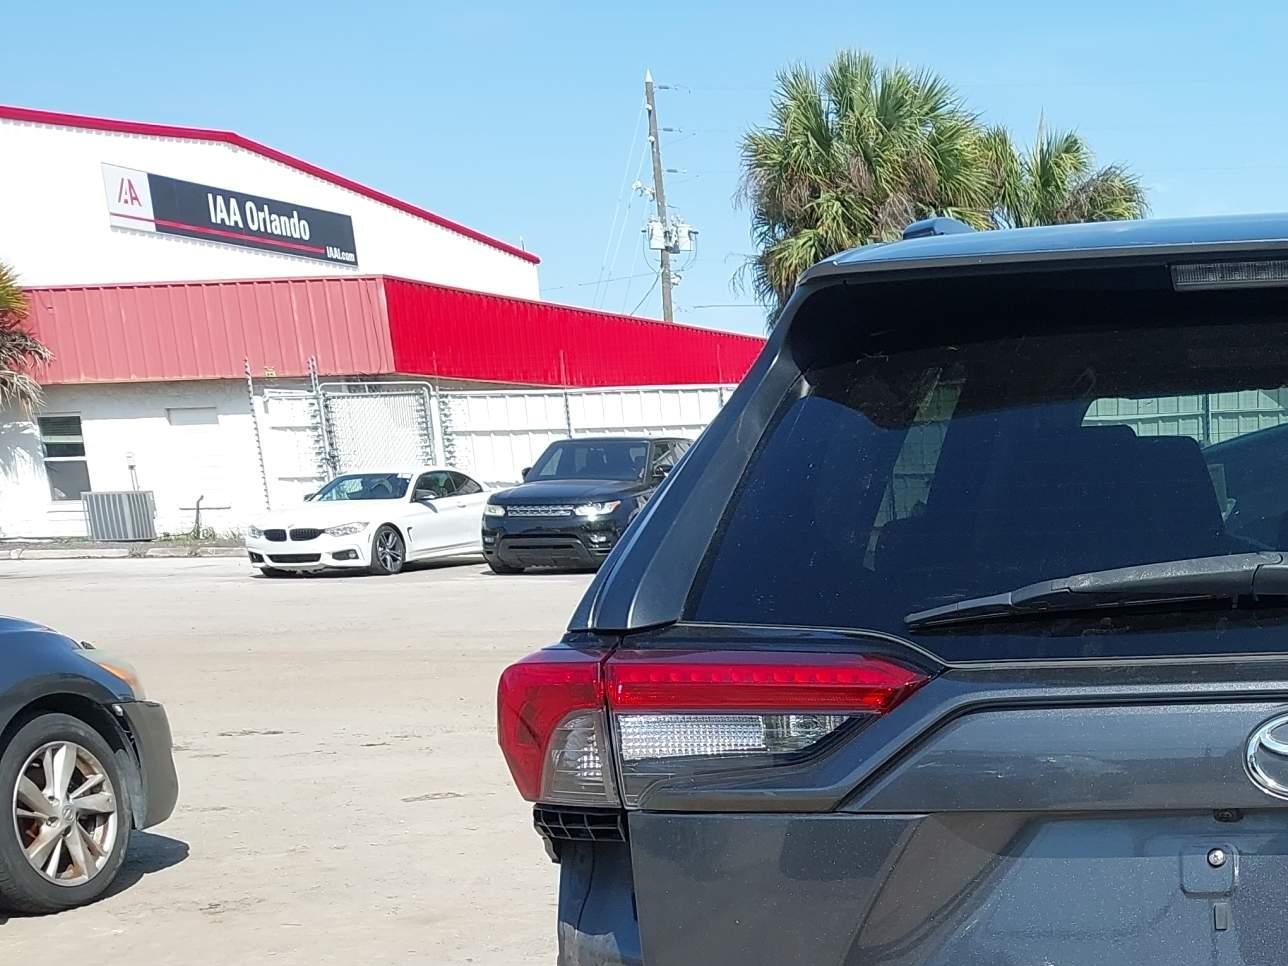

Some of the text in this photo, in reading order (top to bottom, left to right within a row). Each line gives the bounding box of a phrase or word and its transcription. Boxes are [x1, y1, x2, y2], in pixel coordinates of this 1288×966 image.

[207, 192, 310, 241] IAA Orlando
[326, 246, 355, 262] IAAI.com
